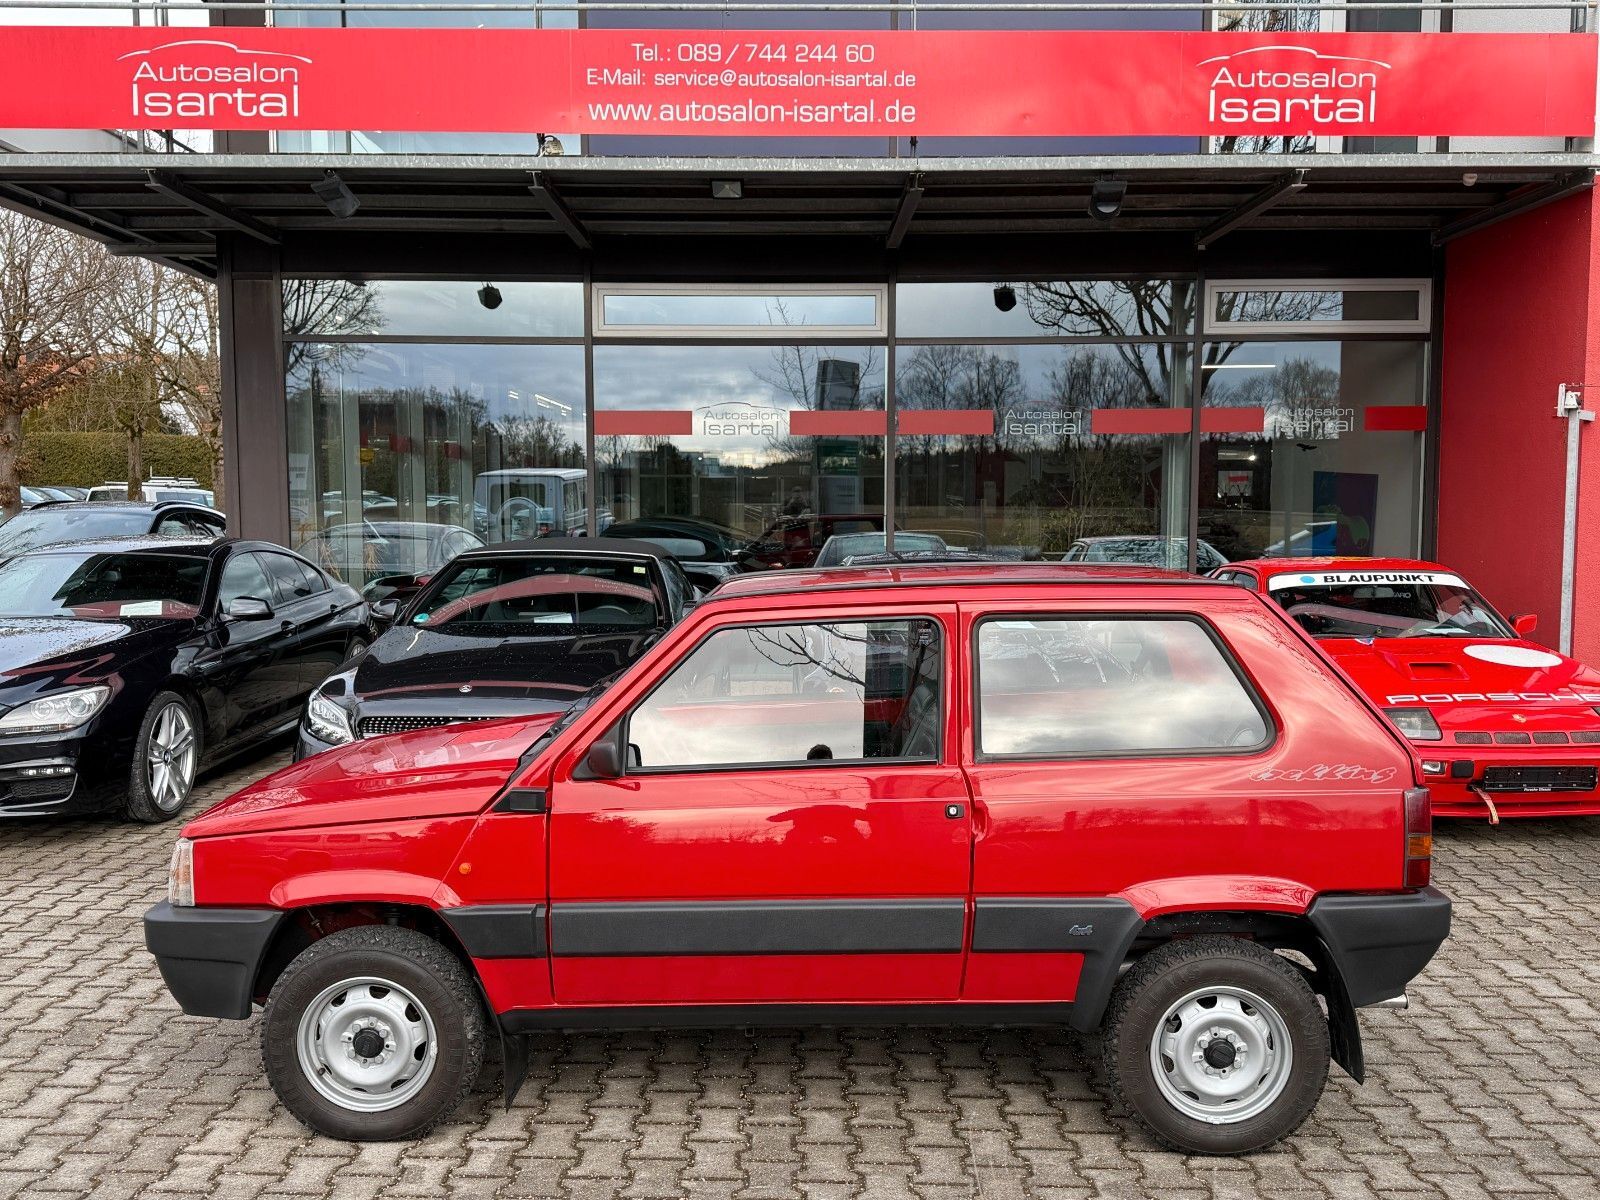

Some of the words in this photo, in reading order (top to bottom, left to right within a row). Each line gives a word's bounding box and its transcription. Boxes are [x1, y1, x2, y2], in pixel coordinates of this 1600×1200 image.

[631, 43, 671, 62] Tel.:
[795, 44, 838, 63] 244
[845, 44, 875, 63] 60
[133, 62, 299, 83] Autosalon
[586, 68, 646, 86] E-Mail:
[654, 69, 916, 87] service@autosalon-isartal.de
[1211, 67, 1377, 89] Autosalon
[132, 84, 299, 117] Isartal
[1209, 90, 1376, 123] Isartal
[588, 98, 916, 123] www.autosalon-isartal.de
[703, 410, 779, 421] Autosalon
[1005, 409, 1082, 420] Autosalon
[703, 420, 779, 436] Isartal
[1004, 419, 1082, 435] Isartal
[1323, 574, 1435, 583] BLAUPUNKT
